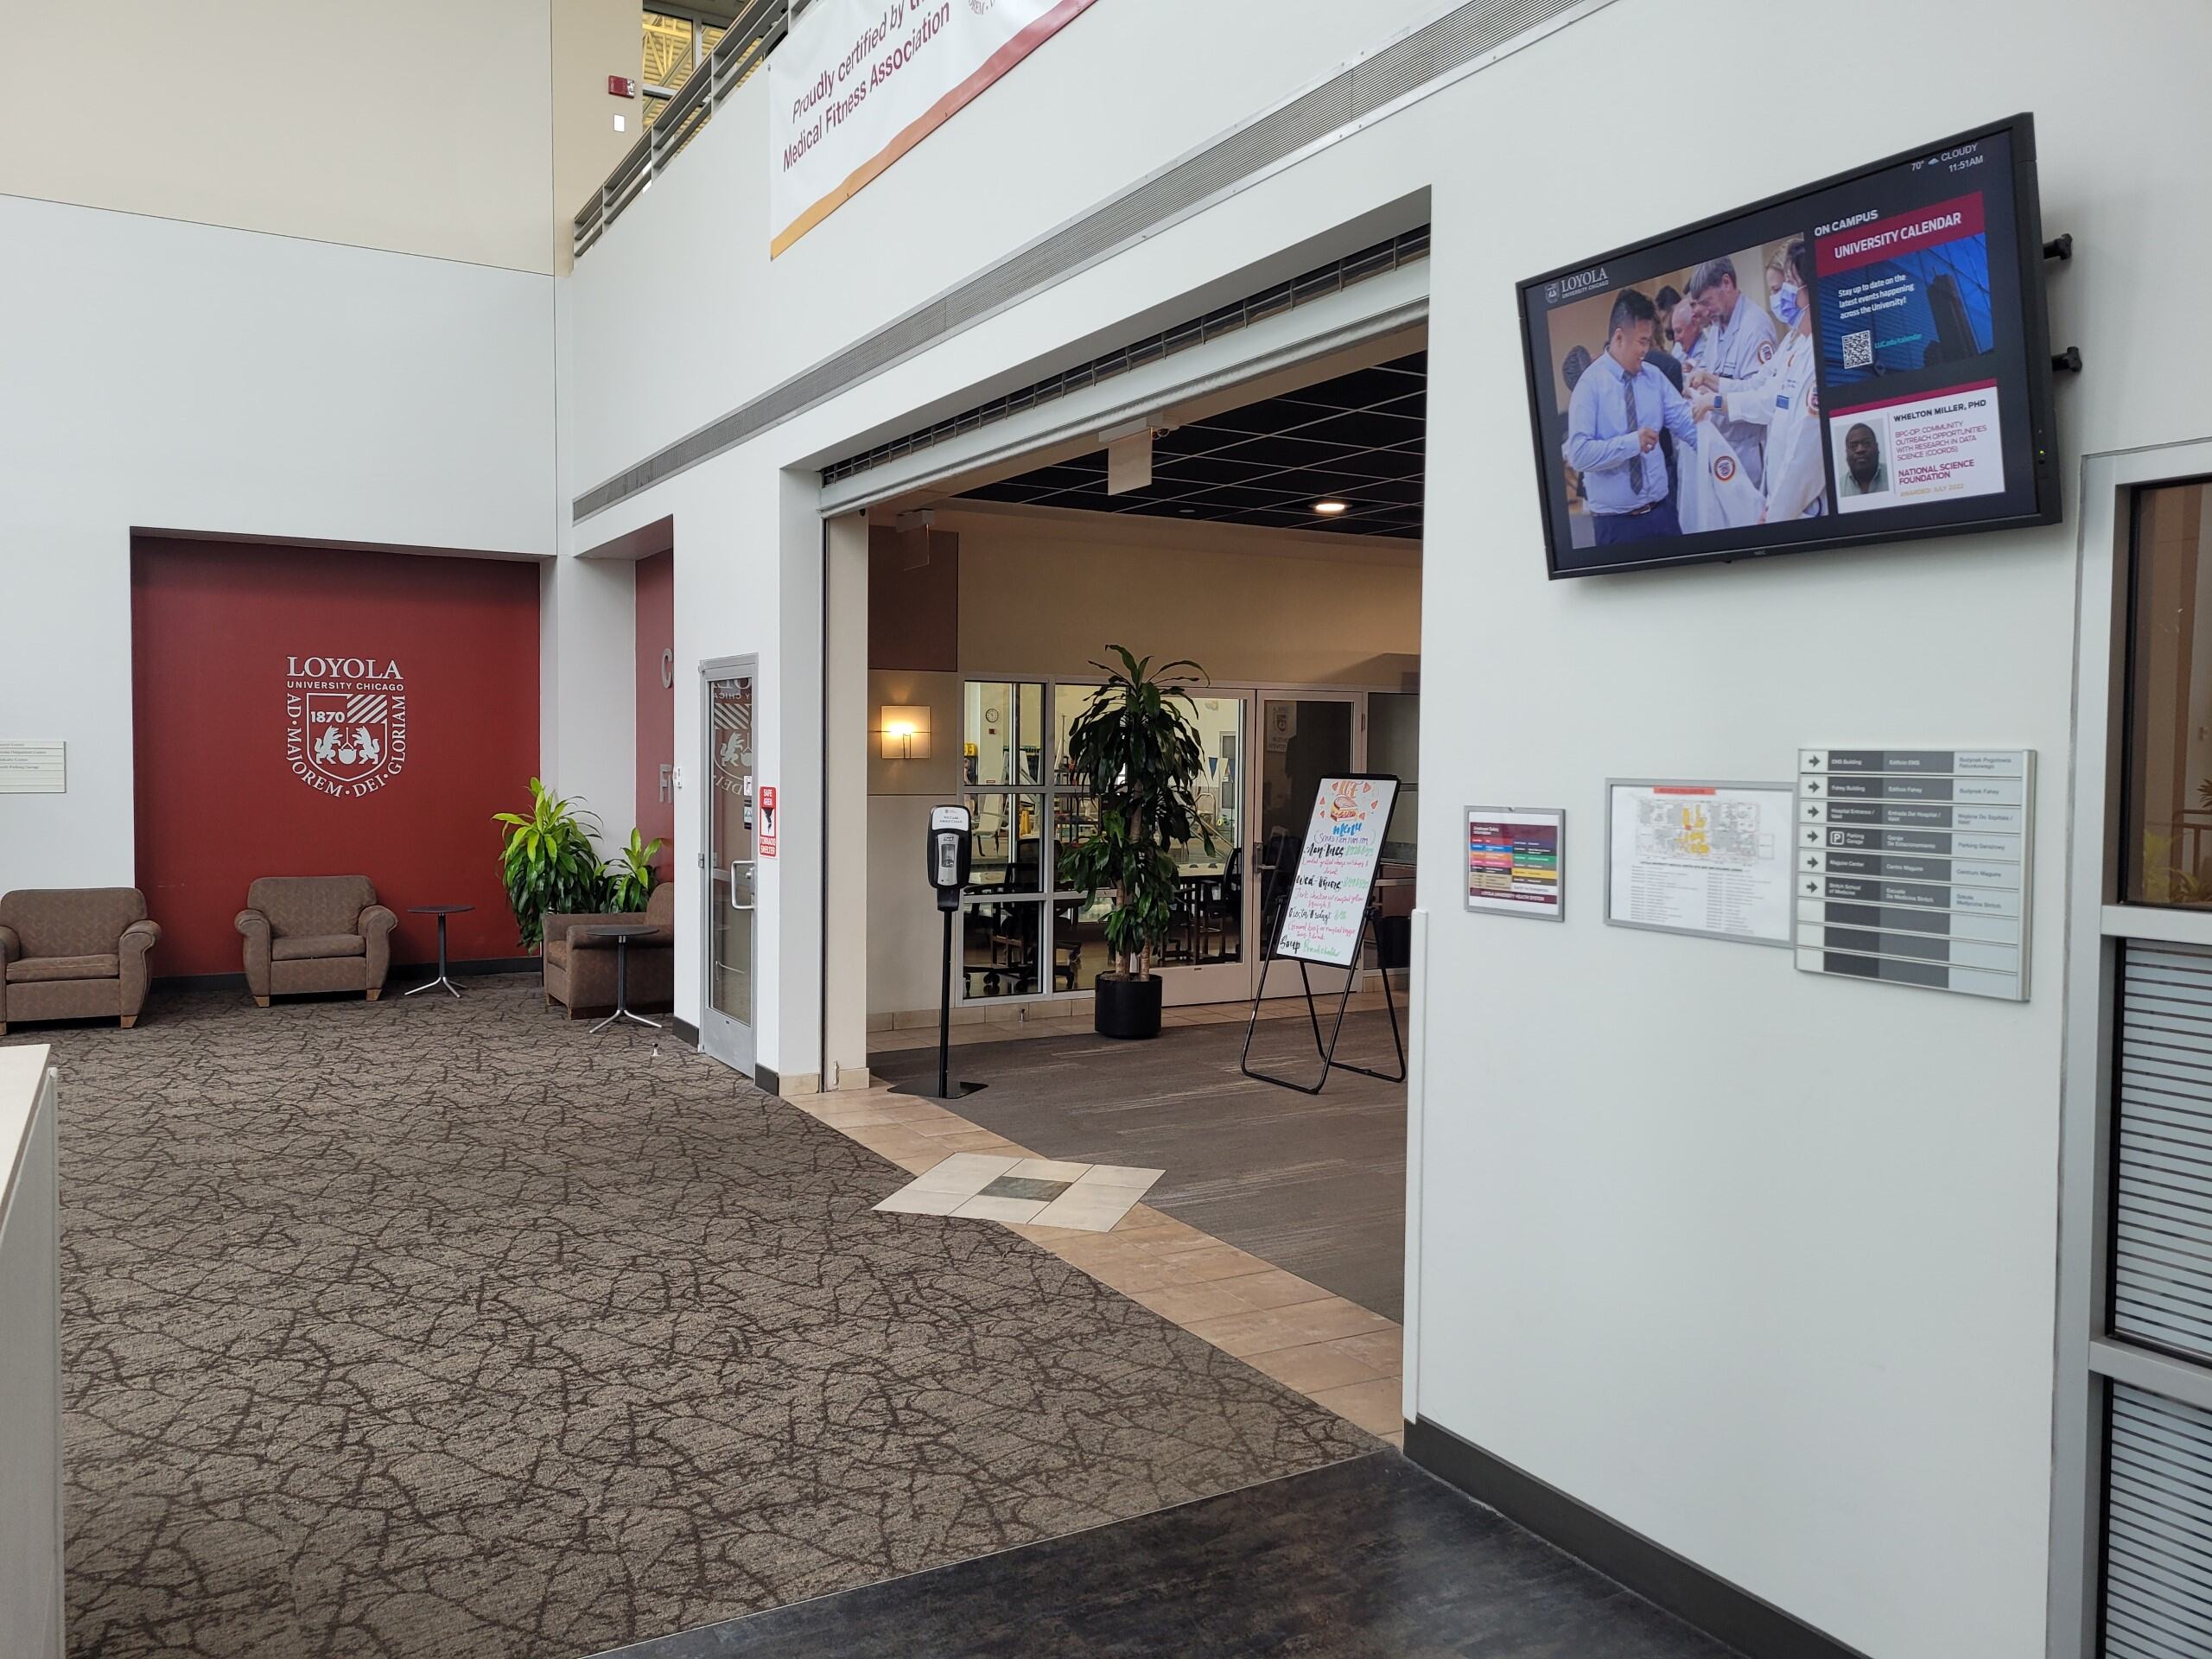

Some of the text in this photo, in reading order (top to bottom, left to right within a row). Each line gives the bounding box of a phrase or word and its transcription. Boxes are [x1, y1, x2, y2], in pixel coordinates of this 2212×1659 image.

[792, 0, 904, 124] Proudly certified by
[784, 2, 949, 172] Medical Fitness Association
[1941, 143, 1978, 162] CLOUDY
[1948, 155, 1983, 172] 11:51AM
[1814, 209, 1878, 237] ON CAMPUS
[1834, 212, 1962, 258] UNIVERSITY CALENDAR
[1560, 267, 1608, 292] LOYOLA
[1838, 289, 1853, 297] Stay
[1869, 279, 1885, 289] date
[1894, 274, 1906, 283] the
[1839, 283, 1915, 308] latest events happening
[1840, 308, 1860, 320] across
[1872, 296, 1907, 311] University!
[1894, 399, 1986, 422] WHELTON MILLER, PHD
[1896, 425, 1987, 446] OUTREACH OPPORTUNITIES
[1922, 421, 1963, 433] COMMUNITY
[1896, 445, 1913, 454] WITH
[1915, 440, 1949, 450] RESEARCH
[1959, 435, 1977, 443] DATA
[1897, 451, 1923, 461] SCIENCE
[1898, 459, 1974, 477] NATIONAL SCIENCE
[1899, 471, 1950, 485] FOUNDATION
[286, 657, 404, 680] LOYOLA
[287, 681, 404, 691] UNIVERSITY CHICAGO
[287, 693, 302, 718] AD
[311, 711, 345, 723] 1870
[387, 696, 405, 775] GLORIAM
[286, 728, 344, 798] MAJOREM
[353, 774, 386, 798] DEI
[763, 788, 772, 797] SAFE
